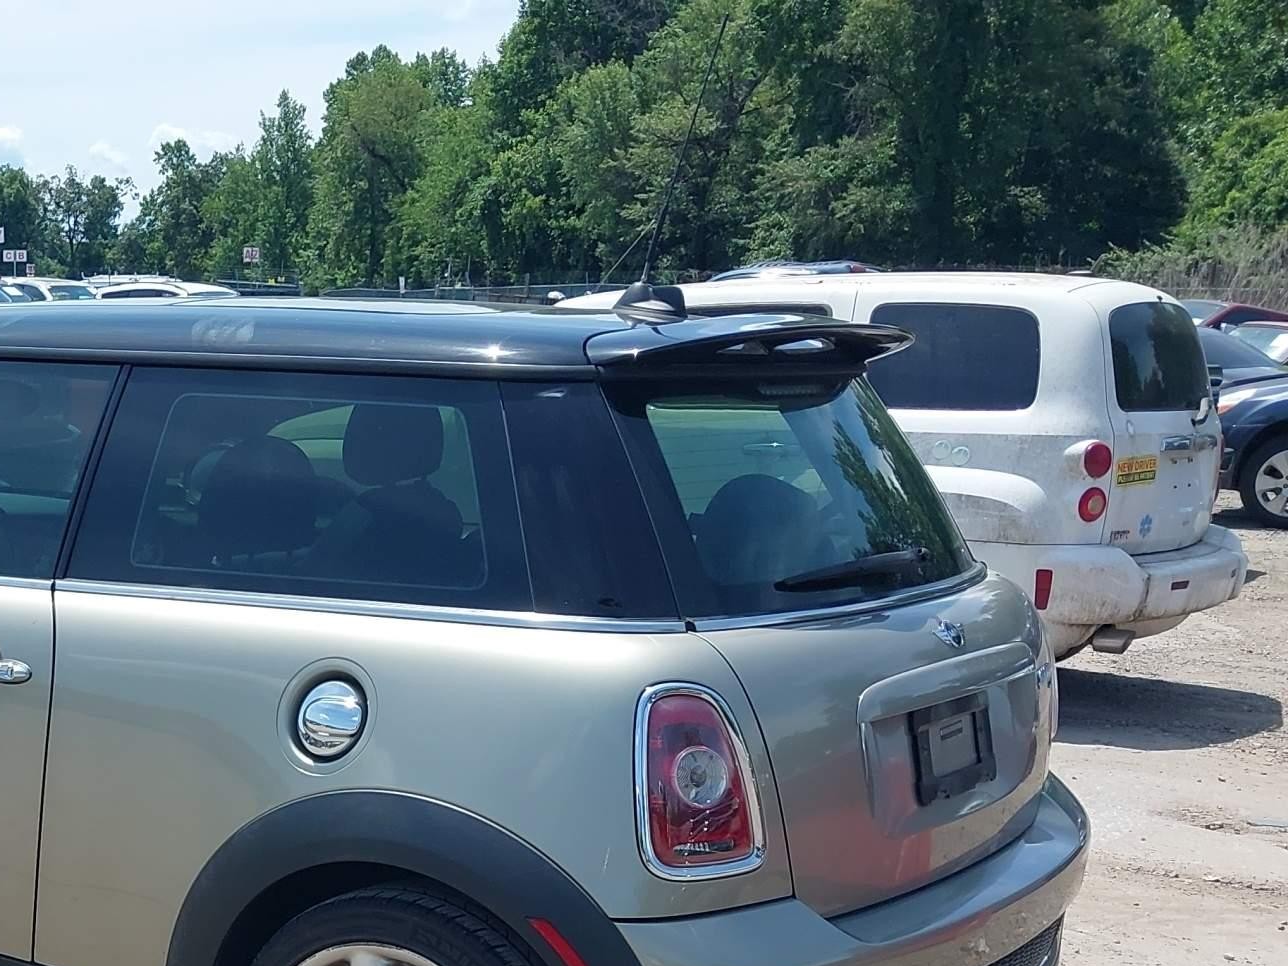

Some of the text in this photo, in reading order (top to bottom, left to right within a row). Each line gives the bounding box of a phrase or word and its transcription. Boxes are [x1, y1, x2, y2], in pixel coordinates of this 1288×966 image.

[5, 252, 12, 260] C
[18, 252, 25, 260] B
[1117, 462, 1133, 473] NEW
